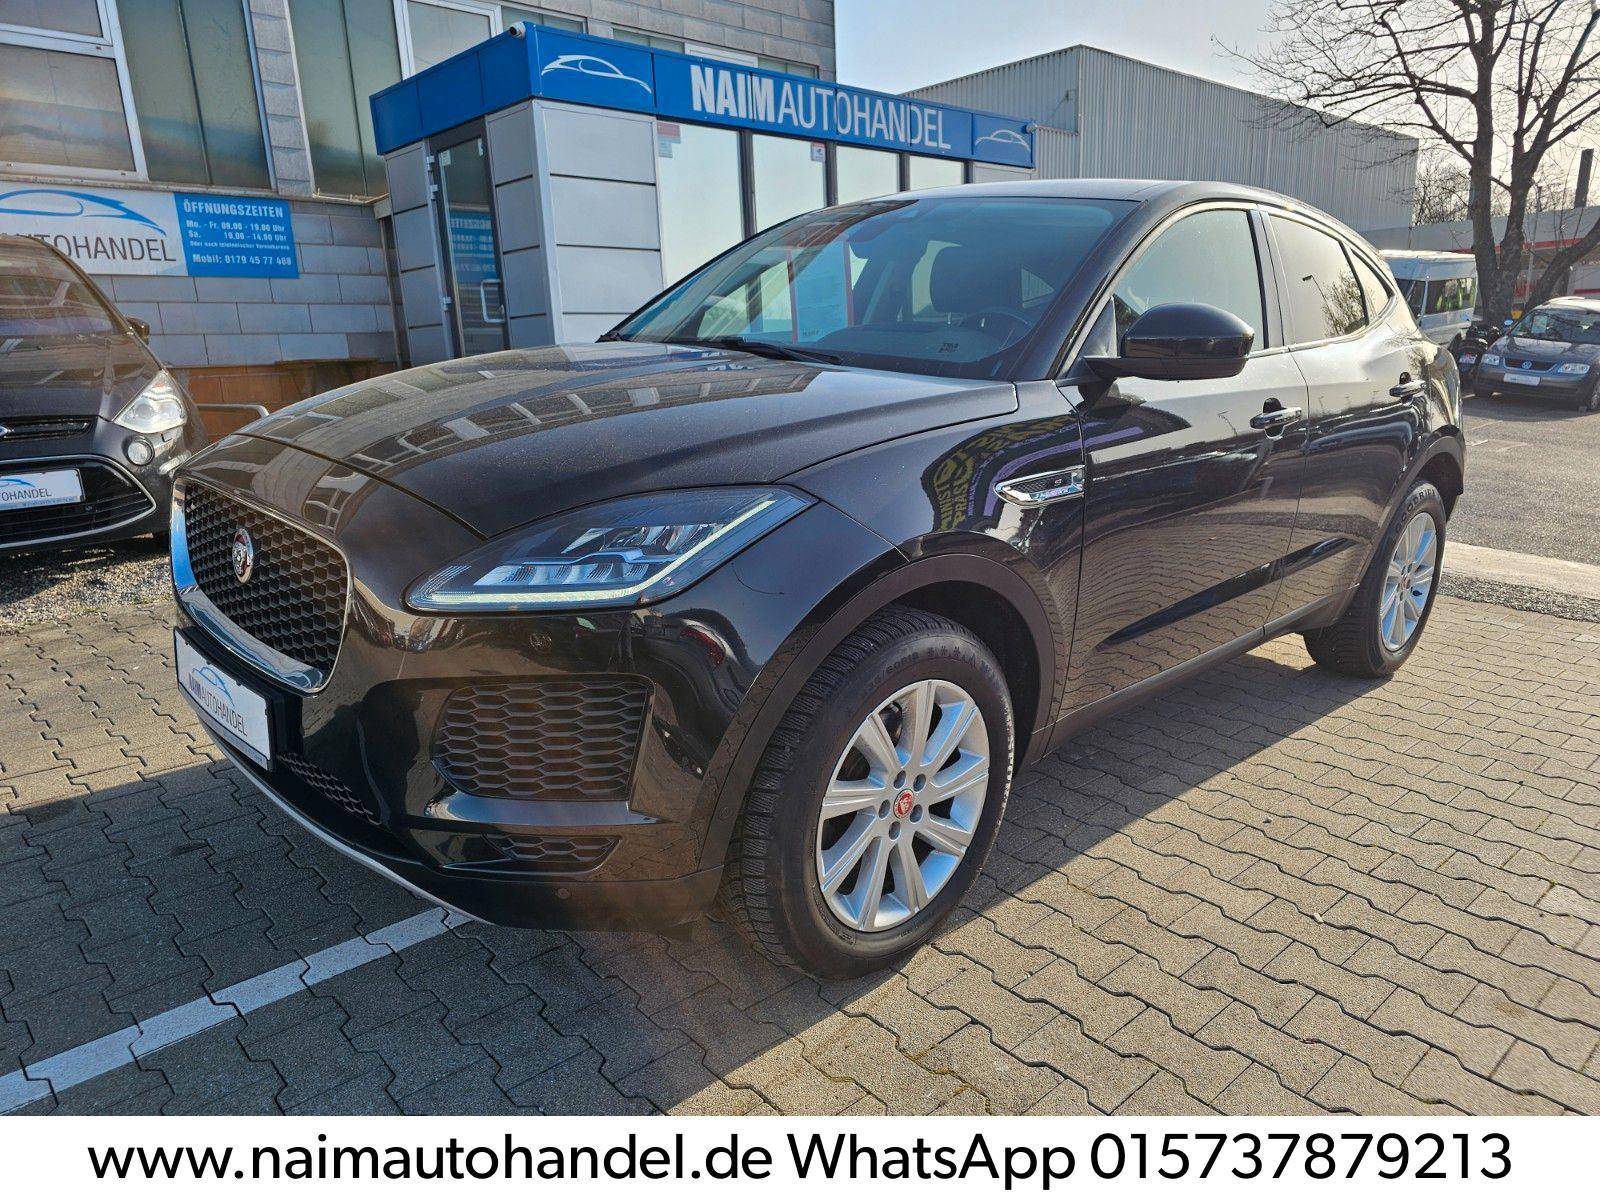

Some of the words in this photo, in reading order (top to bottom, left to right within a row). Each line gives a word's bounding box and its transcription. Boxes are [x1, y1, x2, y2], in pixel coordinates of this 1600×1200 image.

[183, 199, 284, 218] ÖFFNUNGSZEITEN
[209, 221, 219, 229] Fr.
[224, 254, 247, 265] 0179
[249, 256, 261, 265] 45
[262, 256, 274, 265] 77
[0, 488, 53, 502] OHANDEL
